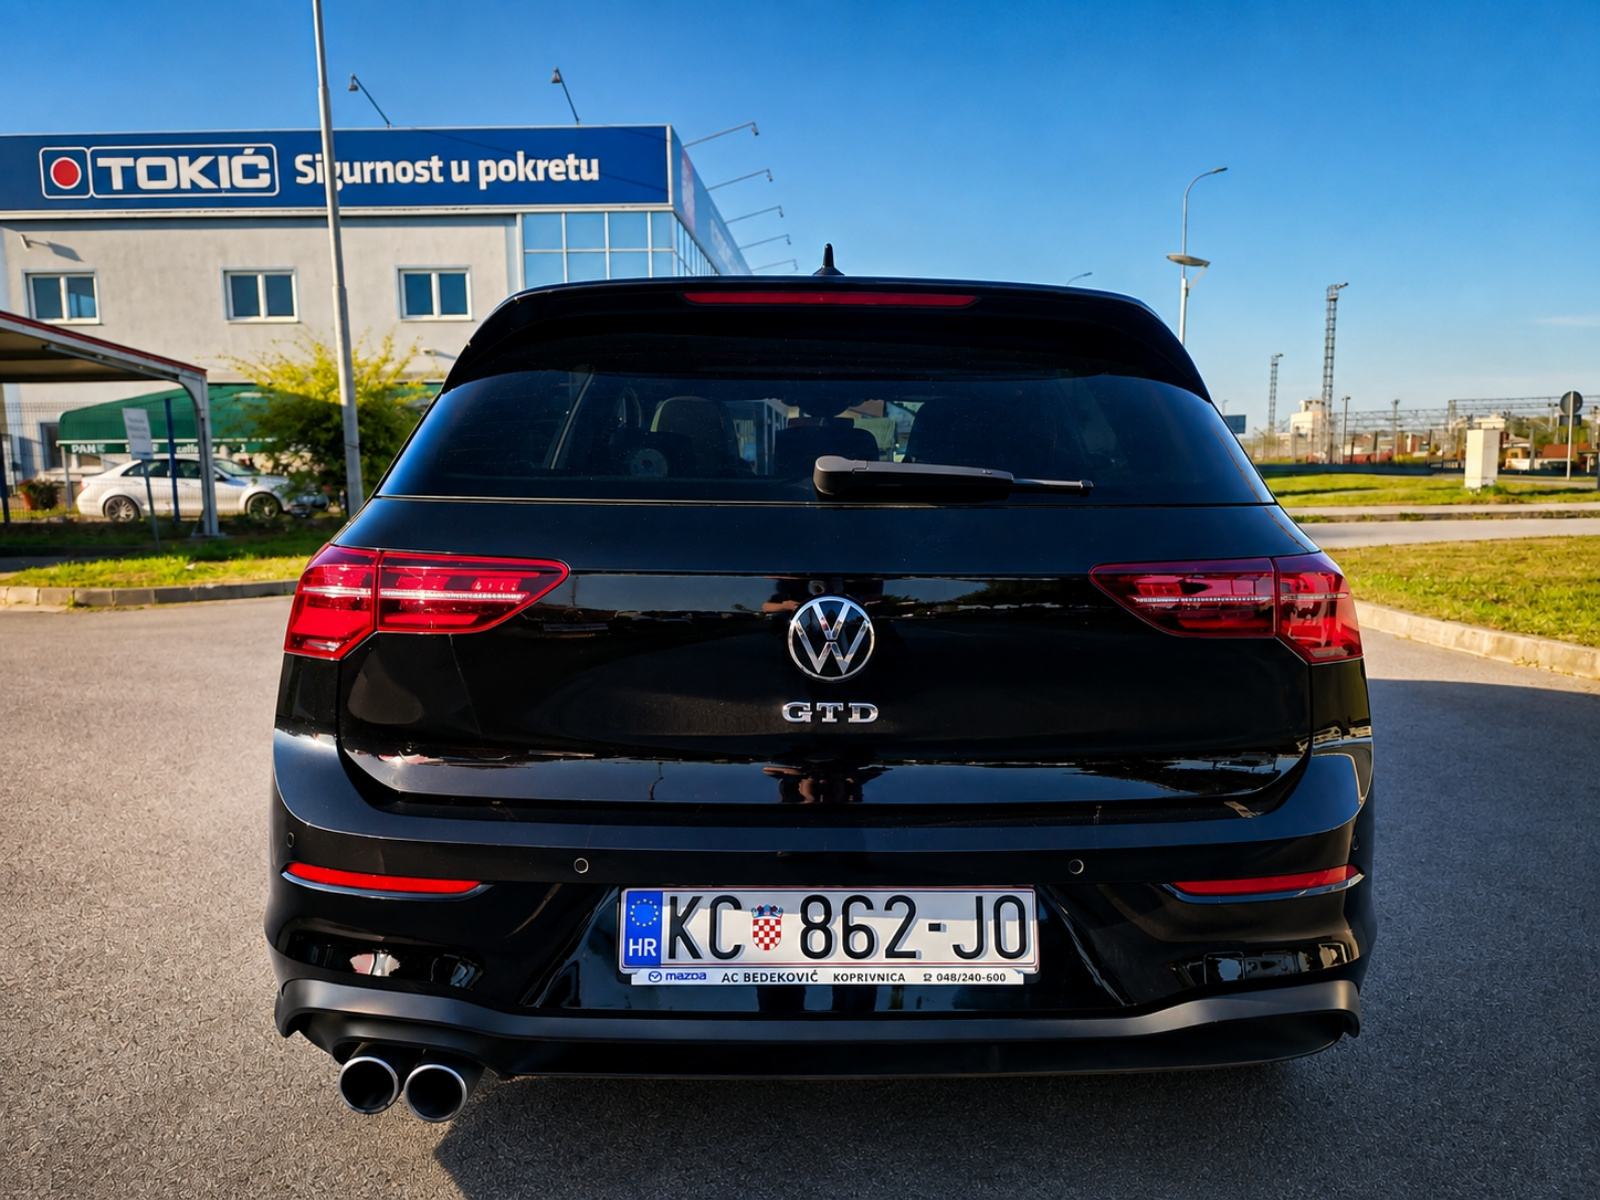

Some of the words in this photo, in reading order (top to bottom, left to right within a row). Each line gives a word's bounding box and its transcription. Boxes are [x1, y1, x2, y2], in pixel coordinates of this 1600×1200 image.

[96, 148, 272, 190] TOKIĆ
[450, 160, 470, 183] u
[478, 151, 600, 190] pokretu
[782, 702, 879, 723] GTD
[668, 895, 742, 960] KC
[628, 938, 657, 957] HR
[721, 972, 739, 983] AC
[743, 970, 818, 983] BEDEKOVIĆ
[833, 972, 906, 983] KOPRIVNICA
[936, 973, 1006, 984] 048/240-600
